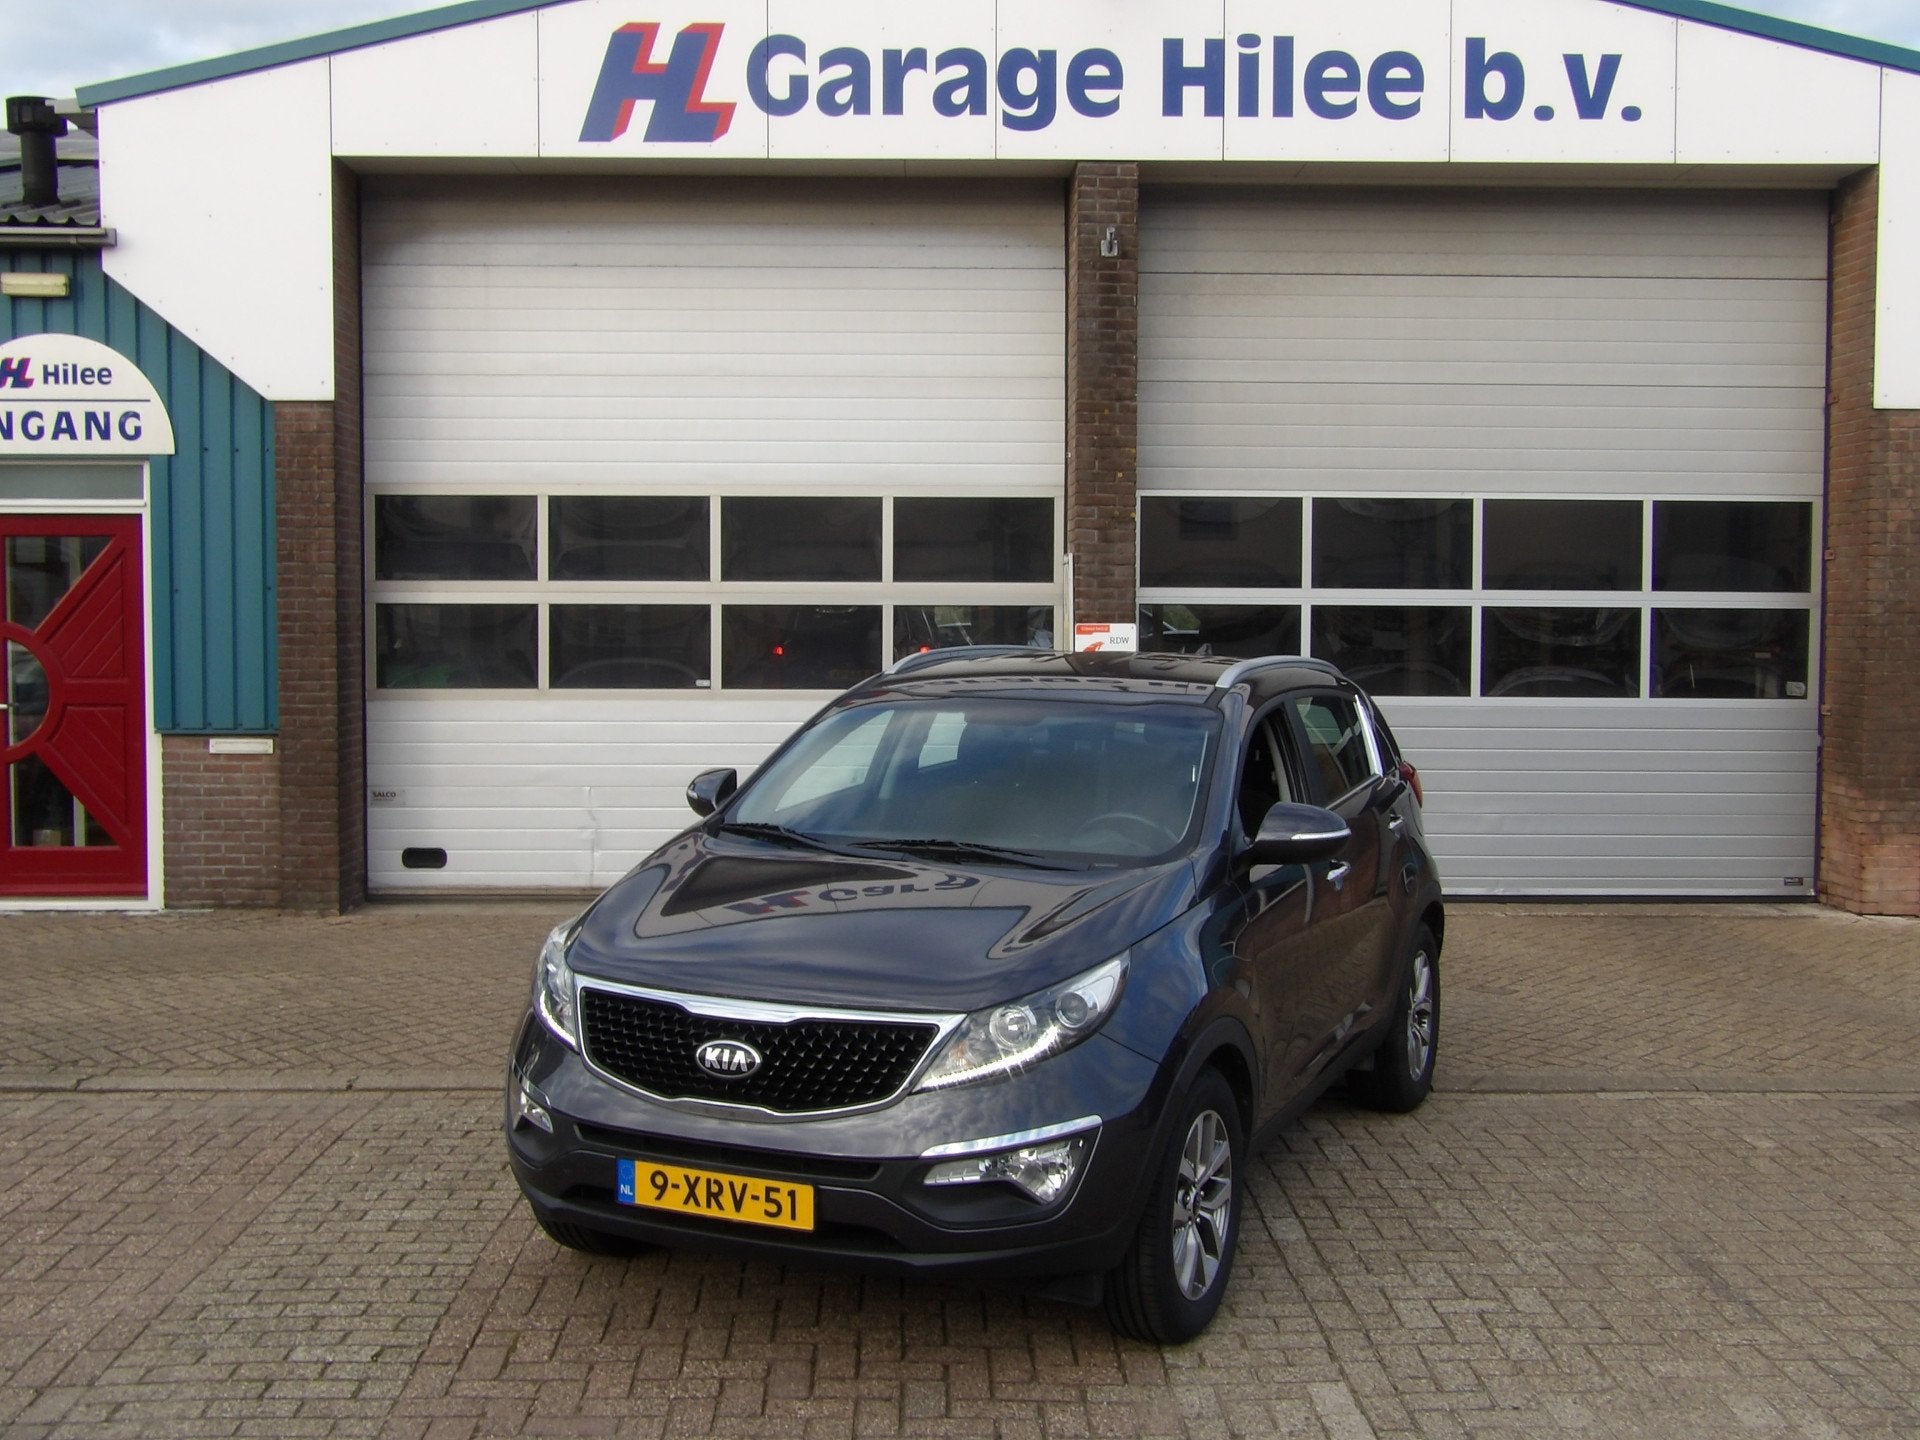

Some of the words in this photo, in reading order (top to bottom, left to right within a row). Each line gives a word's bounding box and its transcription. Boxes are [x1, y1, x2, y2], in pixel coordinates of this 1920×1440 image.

[746, 33, 1124, 132] Garage
[1161, 33, 1425, 120] Hilee
[1464, 37, 1643, 122] b.v.
[43, 363, 112, 385] Hilee
[1109, 636, 1130, 645] RDW
[704, 1046, 748, 1072] KIA
[620, 1184, 633, 1196] NL
[649, 1169, 798, 1221] 9-XRV-51
